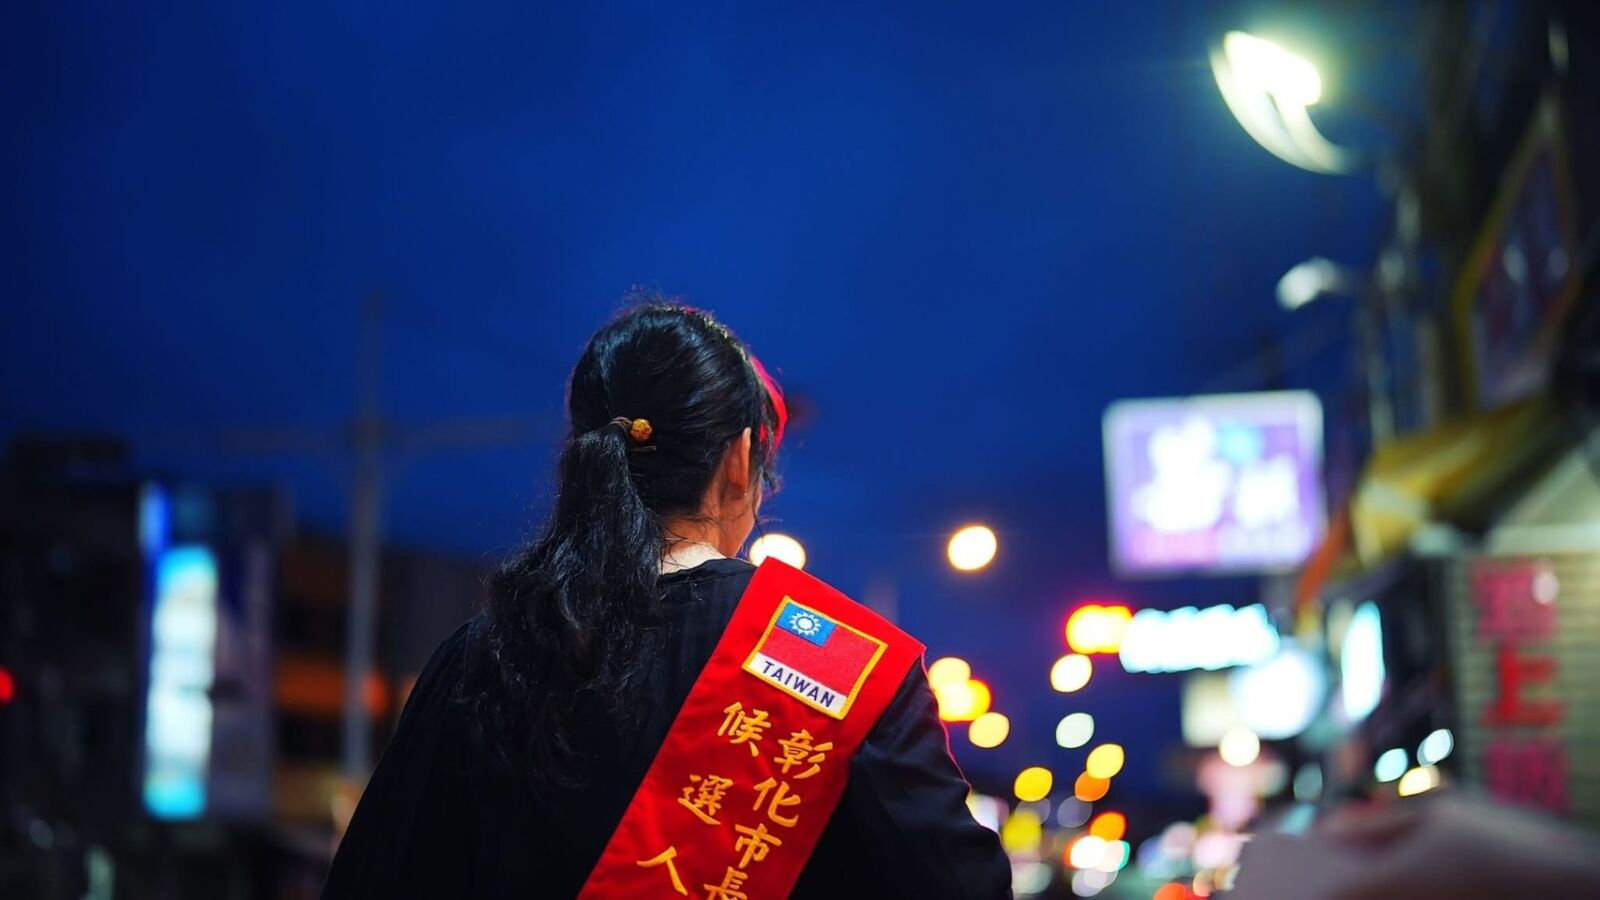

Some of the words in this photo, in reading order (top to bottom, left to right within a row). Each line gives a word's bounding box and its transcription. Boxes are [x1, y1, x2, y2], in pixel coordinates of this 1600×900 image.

[762, 660, 836, 708] TAIWAN
[636, 702, 771, 896] 候選人
